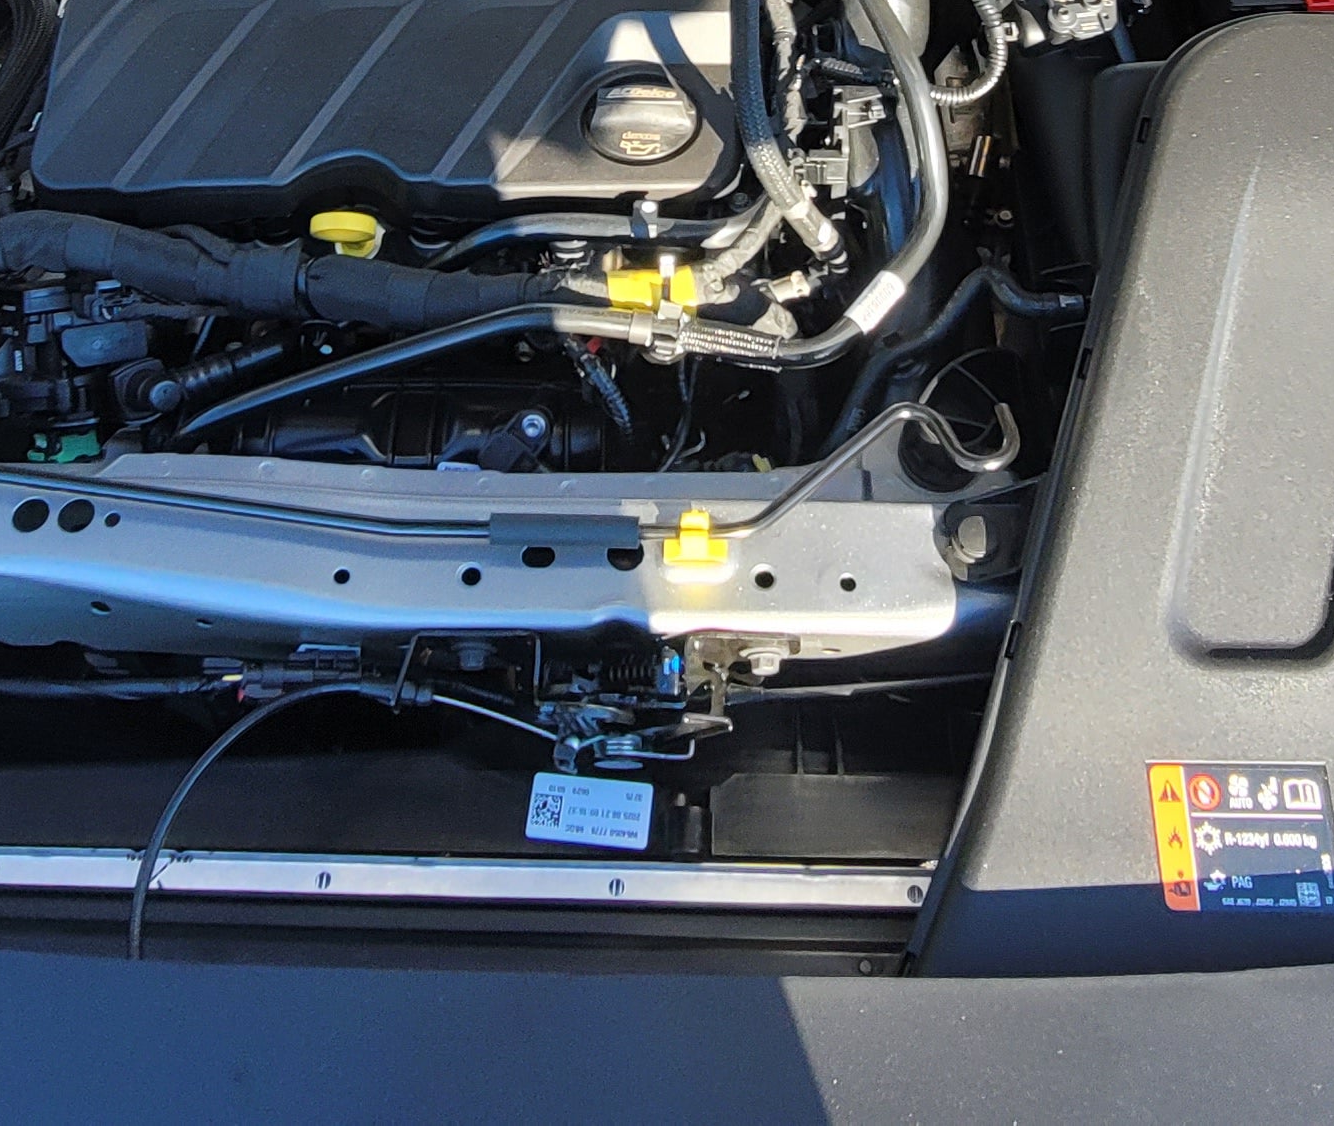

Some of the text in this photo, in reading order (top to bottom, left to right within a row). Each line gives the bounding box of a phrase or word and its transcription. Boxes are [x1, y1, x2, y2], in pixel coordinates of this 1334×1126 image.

[605, 87, 677, 99] ACDelco
[1229, 797, 1254, 809] AUTO
[1303, 833, 1317, 849] kg
[1231, 875, 1254, 889] PAG
